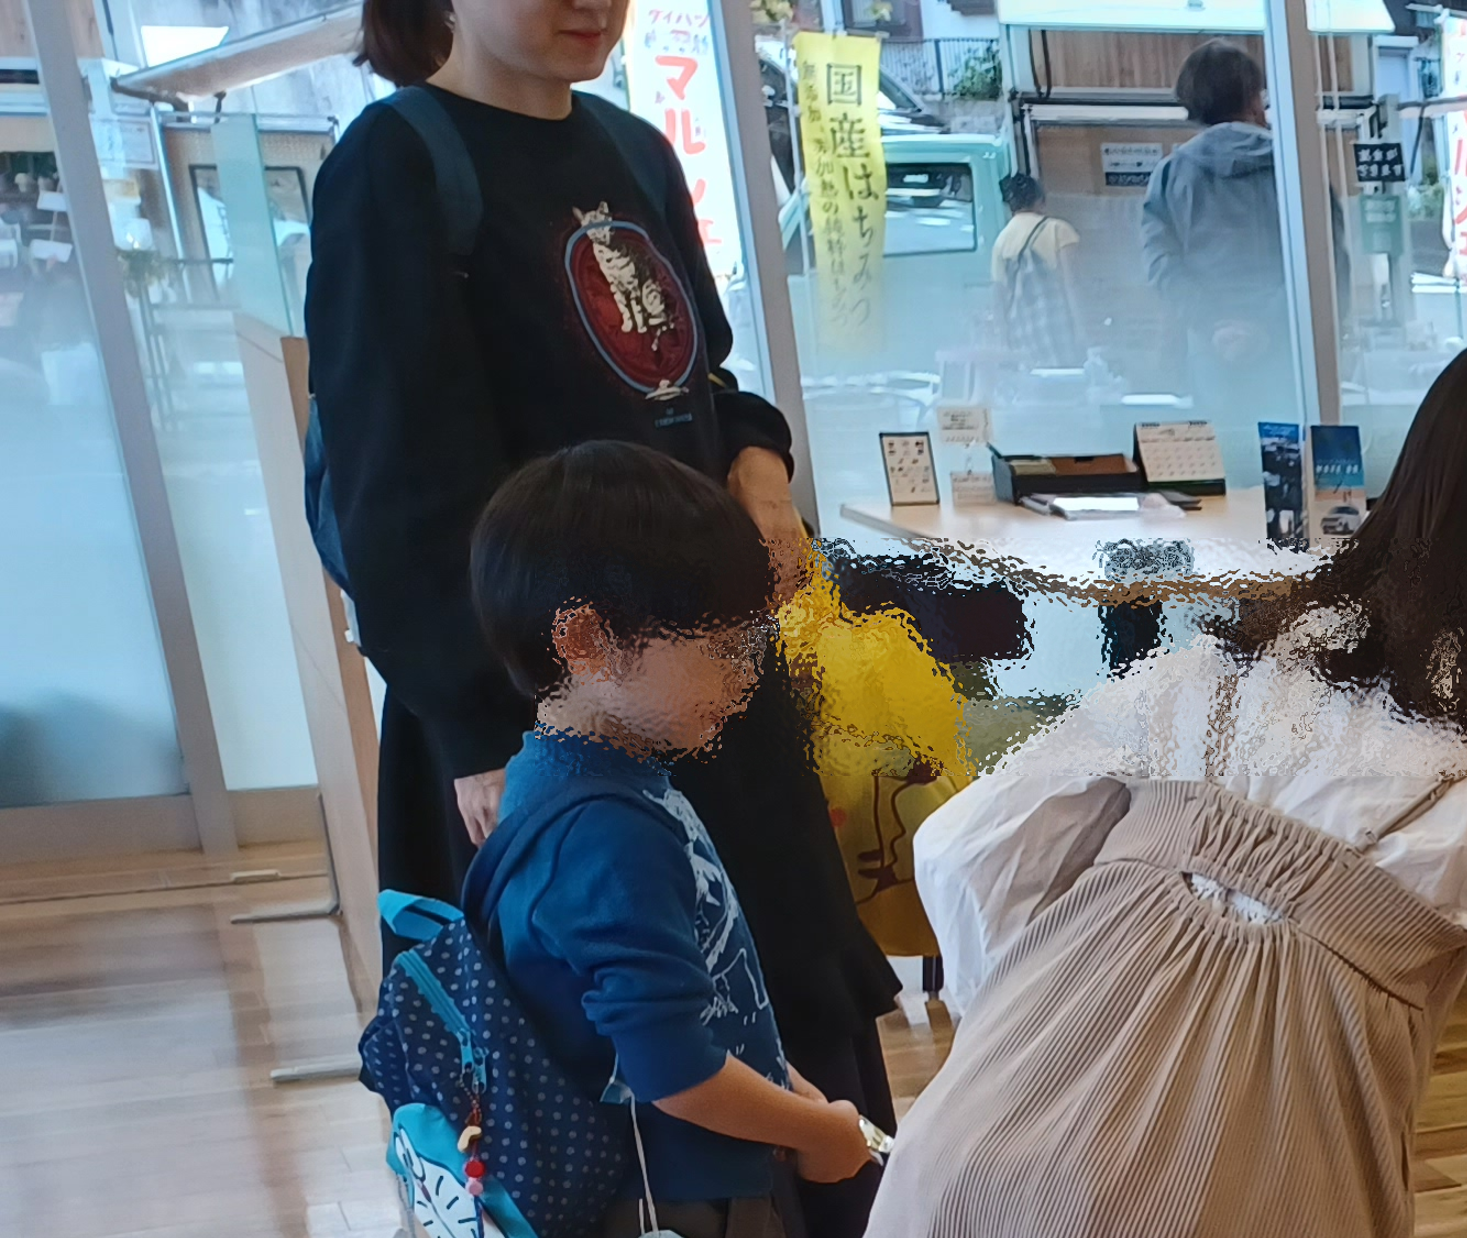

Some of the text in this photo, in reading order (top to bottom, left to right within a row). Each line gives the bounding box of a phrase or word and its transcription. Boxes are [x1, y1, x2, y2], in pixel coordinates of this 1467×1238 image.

[826, 63, 879, 324] 国産はちみつ
